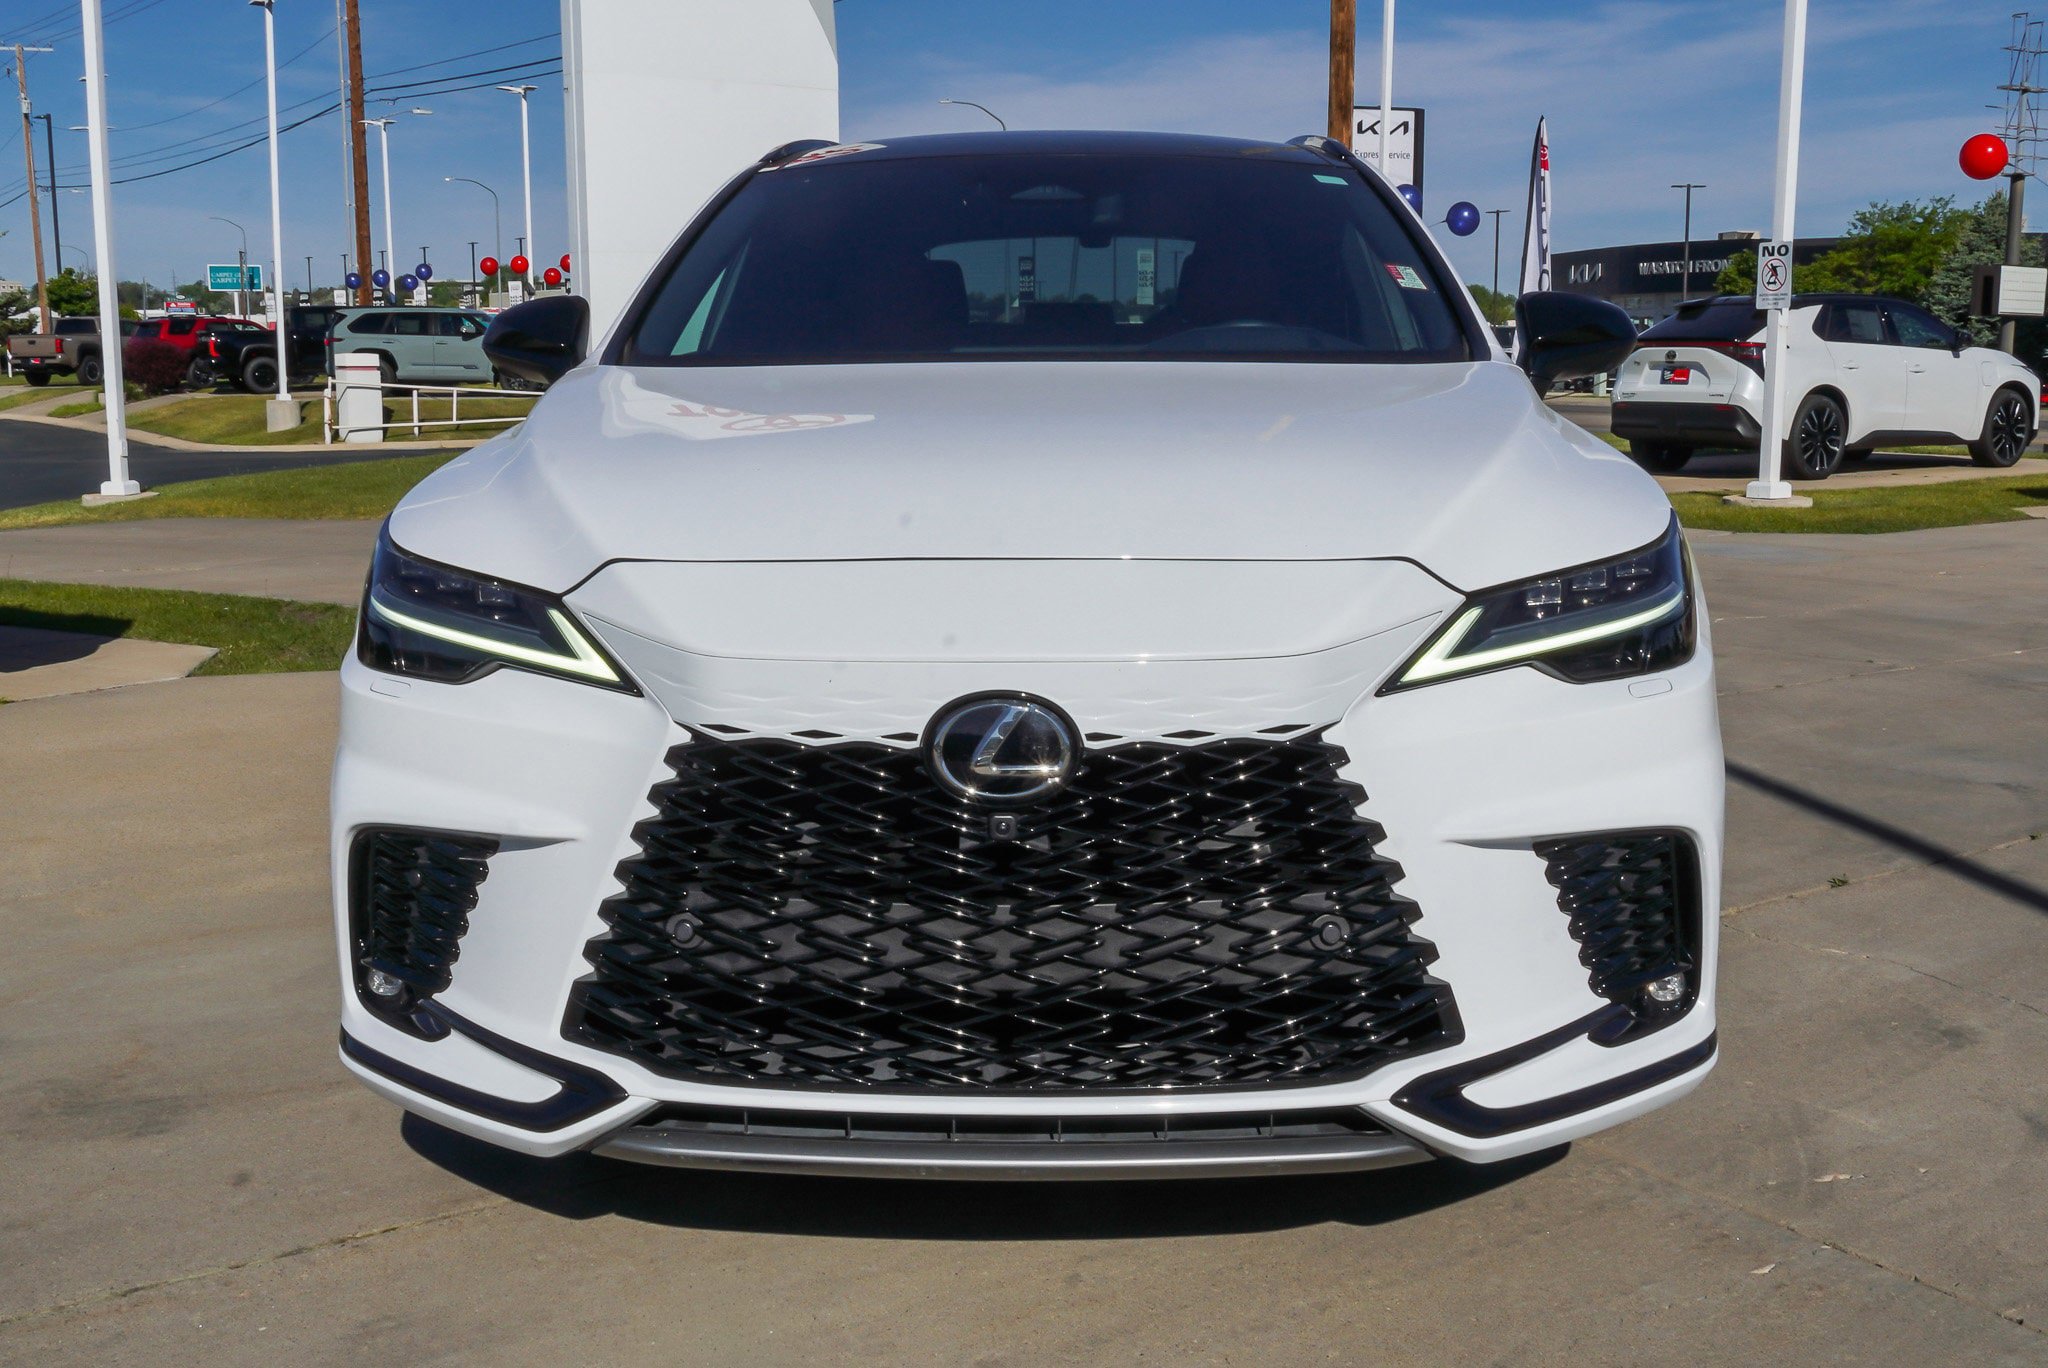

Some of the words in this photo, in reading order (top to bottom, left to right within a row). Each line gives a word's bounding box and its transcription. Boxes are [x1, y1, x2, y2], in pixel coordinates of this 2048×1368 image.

[1357, 120, 1409, 135] KA
[1354, 149, 1379, 159] Expres
[1389, 150, 1411, 159] ervice
[1762, 244, 1789, 257] NO
[1695, 259, 1733, 273] FRON
